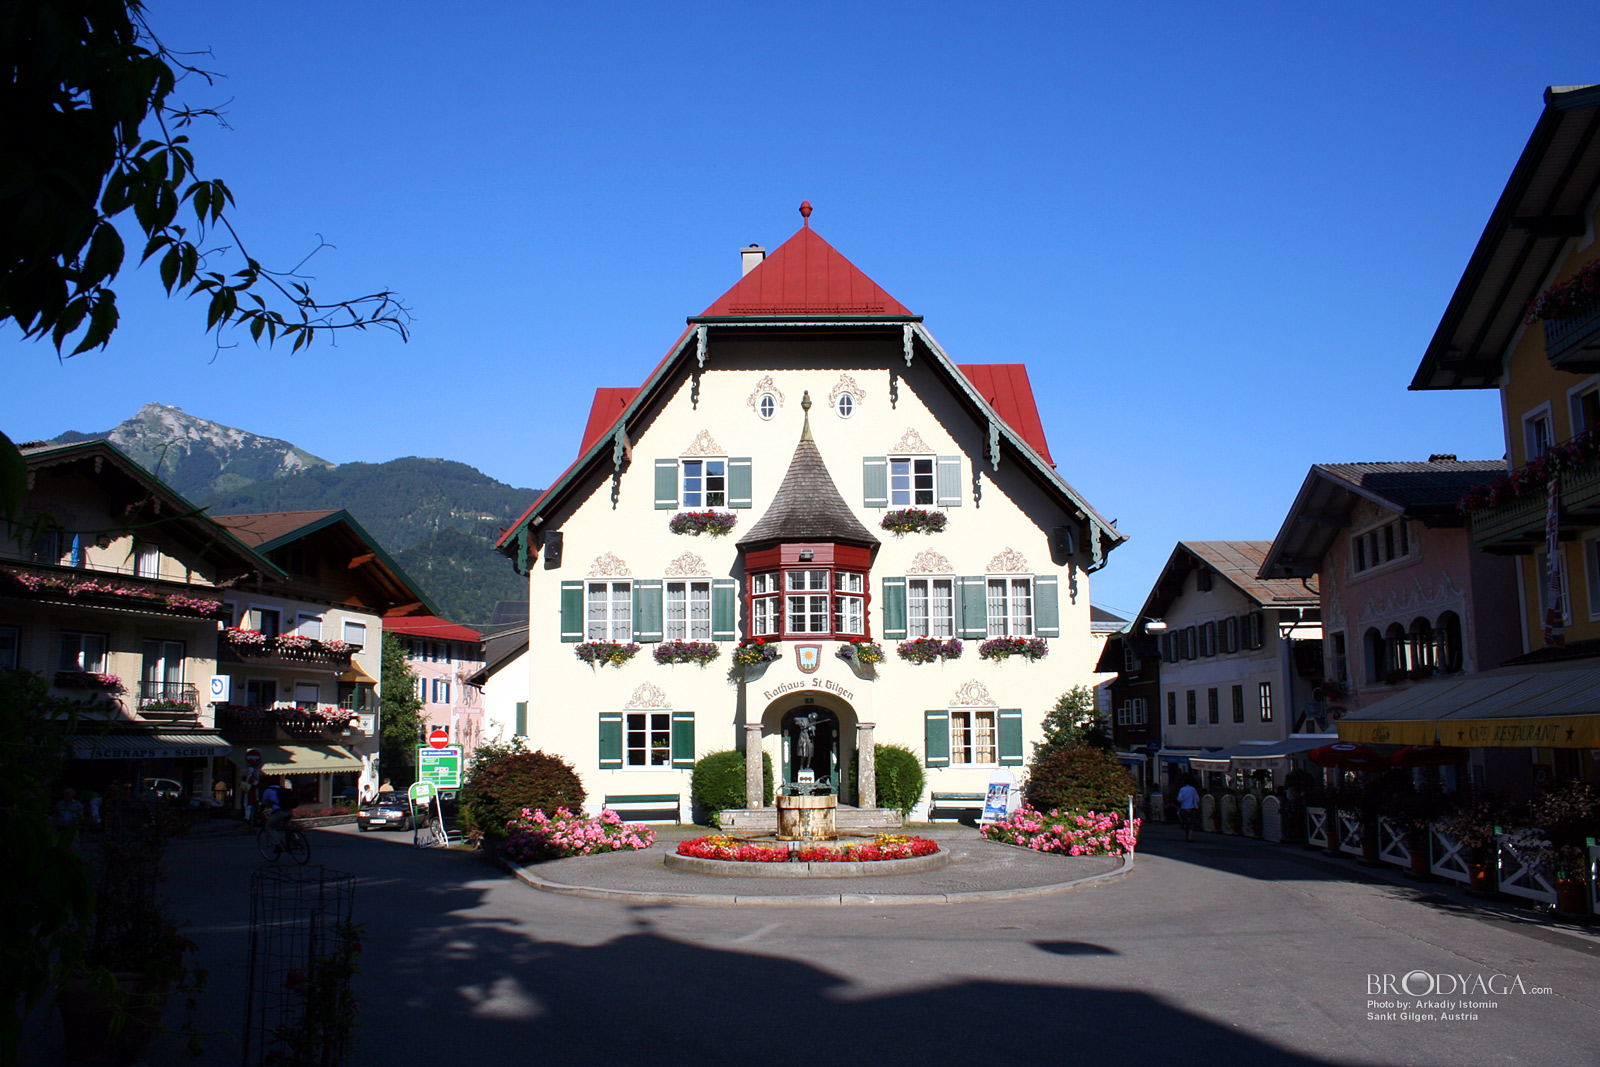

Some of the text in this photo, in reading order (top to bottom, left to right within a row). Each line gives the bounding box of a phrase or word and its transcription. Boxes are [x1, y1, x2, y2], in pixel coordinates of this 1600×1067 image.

[763, 677, 854, 700] Rathaus St. Gilgen
[1493, 724, 1560, 742] RESTAURANT
[95, 749, 156, 758] SCHNAPS
[175, 748, 215, 757] SCHUH
